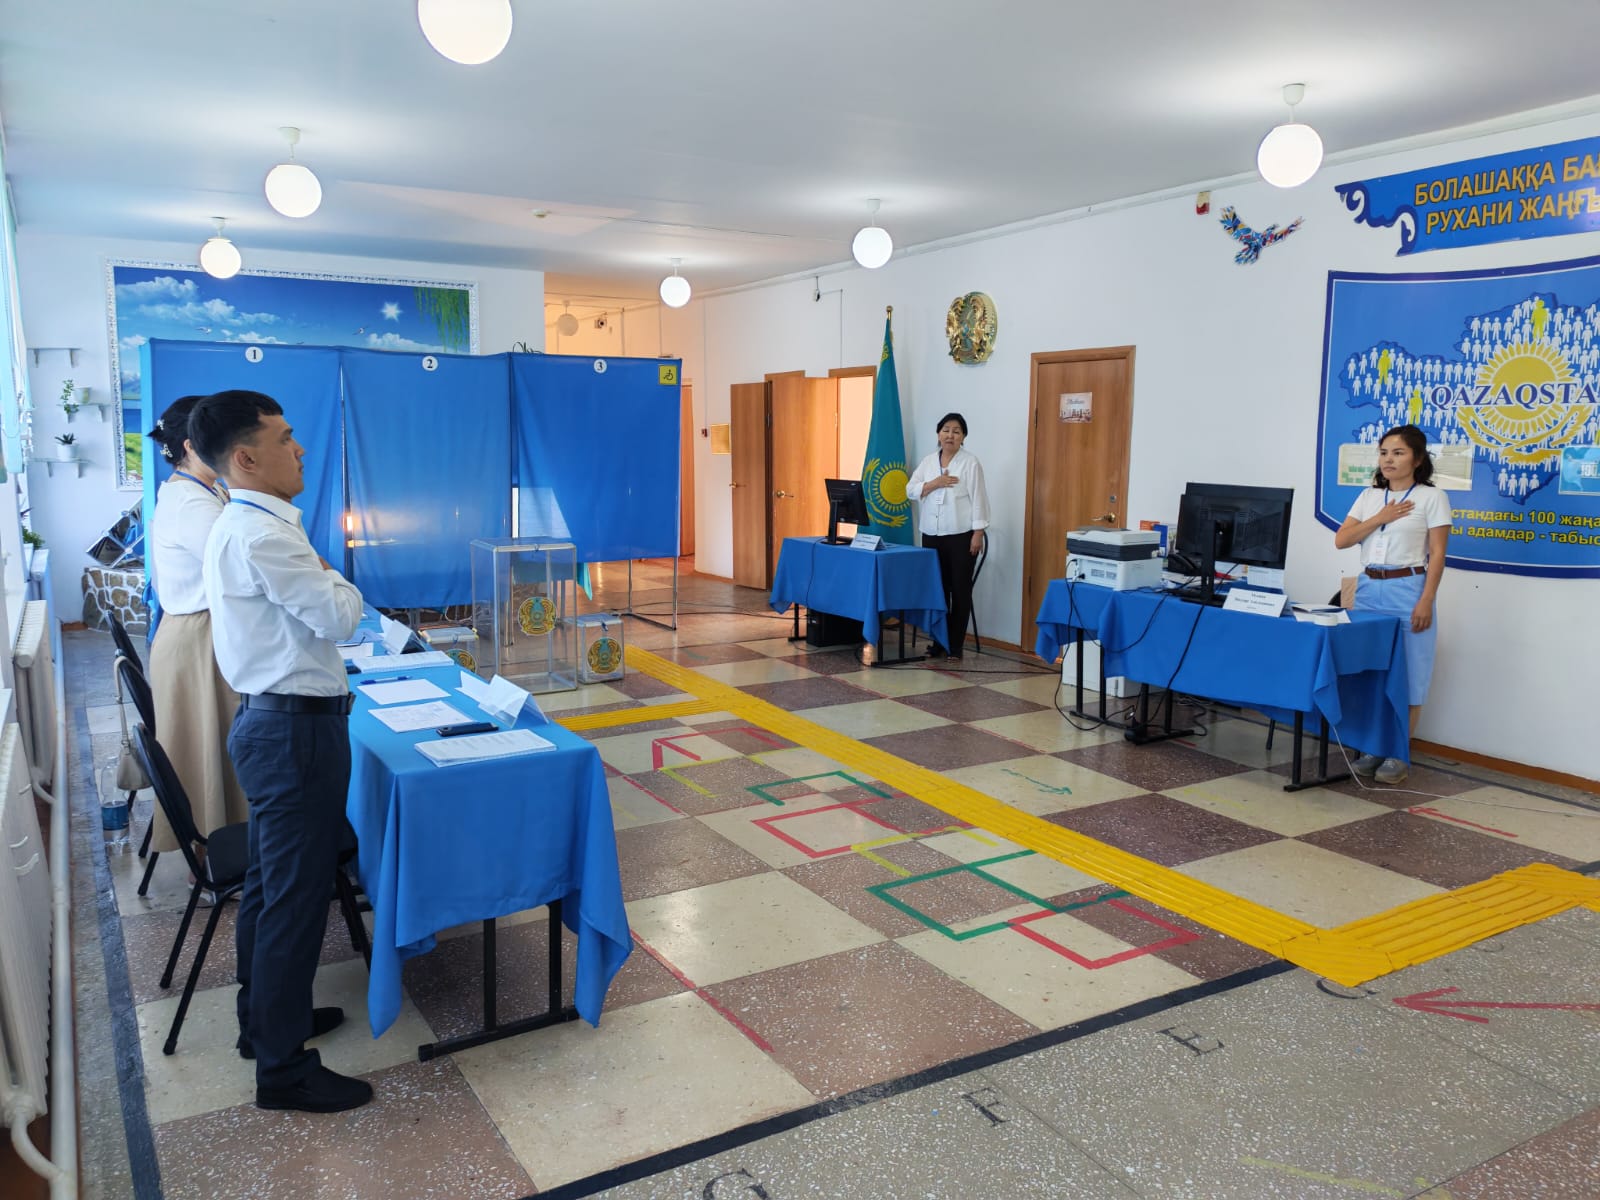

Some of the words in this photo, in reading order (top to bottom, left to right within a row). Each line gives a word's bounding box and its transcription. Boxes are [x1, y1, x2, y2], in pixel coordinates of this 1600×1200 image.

[1414, 161, 1555, 206] БОЛАШАҚҚА
[1426, 200, 1513, 234] РУХАНИ
[426, 358, 433, 369] 2
[596, 361, 604, 371] 3
[1431, 383, 1598, 410] QAZAQSTA
[1528, 510, 1556, 524] 100
[1559, 514, 1600, 528] жаңа
[1467, 526, 1535, 543] адамдар
[961, 1087, 1010, 1127] F
